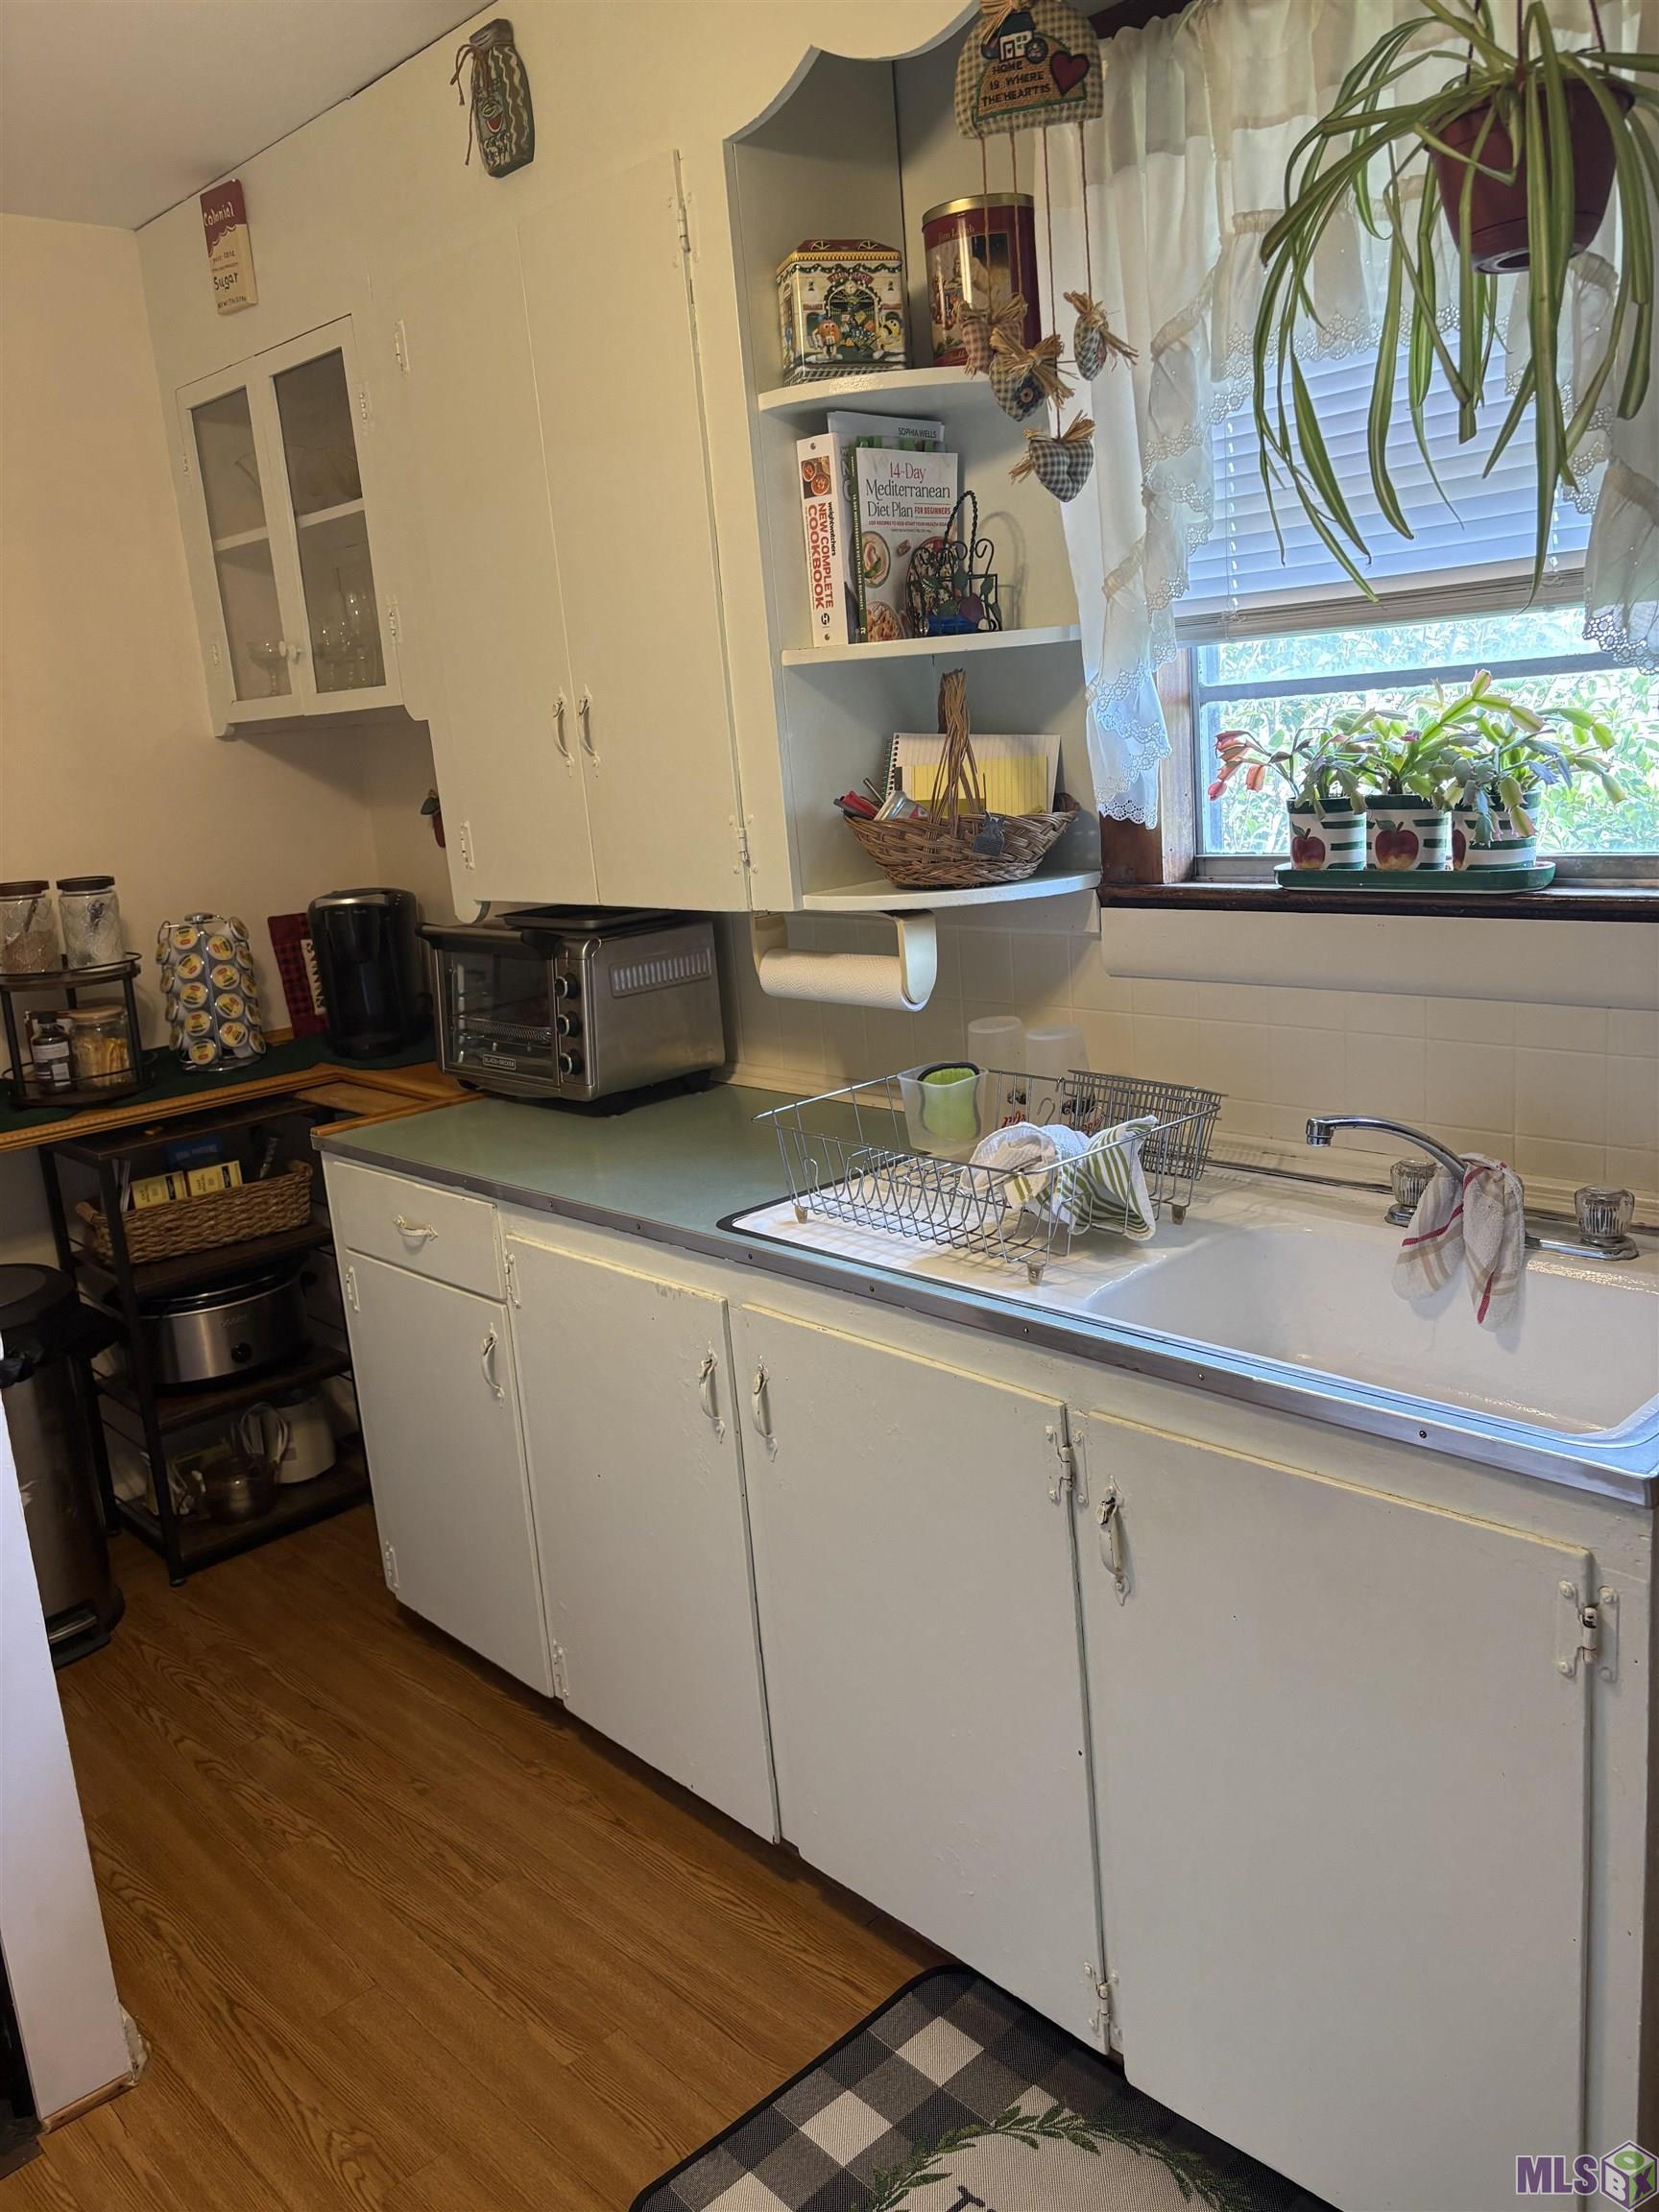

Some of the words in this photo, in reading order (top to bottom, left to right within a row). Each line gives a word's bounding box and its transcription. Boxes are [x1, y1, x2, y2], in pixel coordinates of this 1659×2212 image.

[992, 60, 1023, 75] HOME
[990, 80, 999, 91] IS
[1005, 71, 1045, 85] WHERE
[981, 94, 1002, 107] THE
[203, 201, 235, 227] Colonial
[213, 272, 239, 291] Sugar
[898, 427, 919, 437] SOPHIA
[919, 429, 937, 439] WELLS
[890, 461, 926, 484] 14-Day
[866, 478, 950, 501] Mediterranean
[818, 502, 829, 533] NEW
[867, 500, 891, 517] Diet
[891, 501, 913, 518] Plan
[914, 506, 924, 515] FOR
[924, 506, 950, 516] BEGINNERS
[828, 501, 836, 557] weightwatchers
[808, 504, 825, 610] COOKBOOK
[820, 537, 833, 609] COMPLETE
